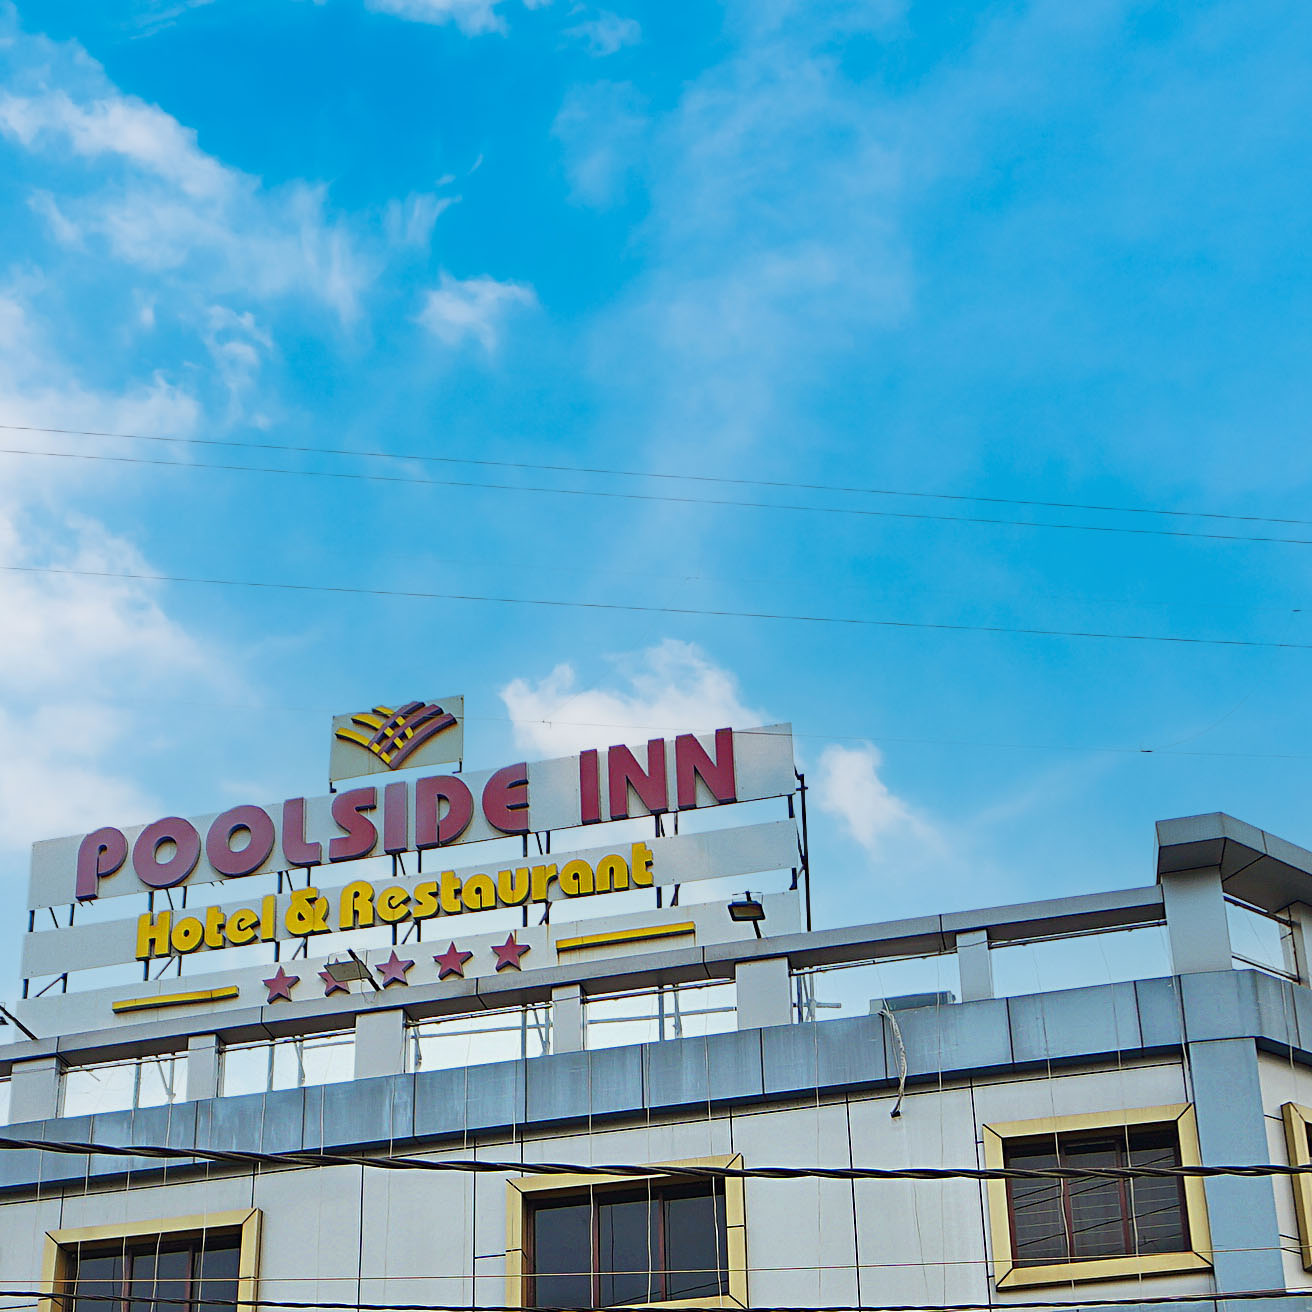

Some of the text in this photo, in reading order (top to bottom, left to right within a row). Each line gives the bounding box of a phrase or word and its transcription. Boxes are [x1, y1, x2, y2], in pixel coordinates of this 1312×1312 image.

[75, 727, 737, 901] POOLSIDE INN
[135, 841, 654, 961] Hotel & Restaurant
